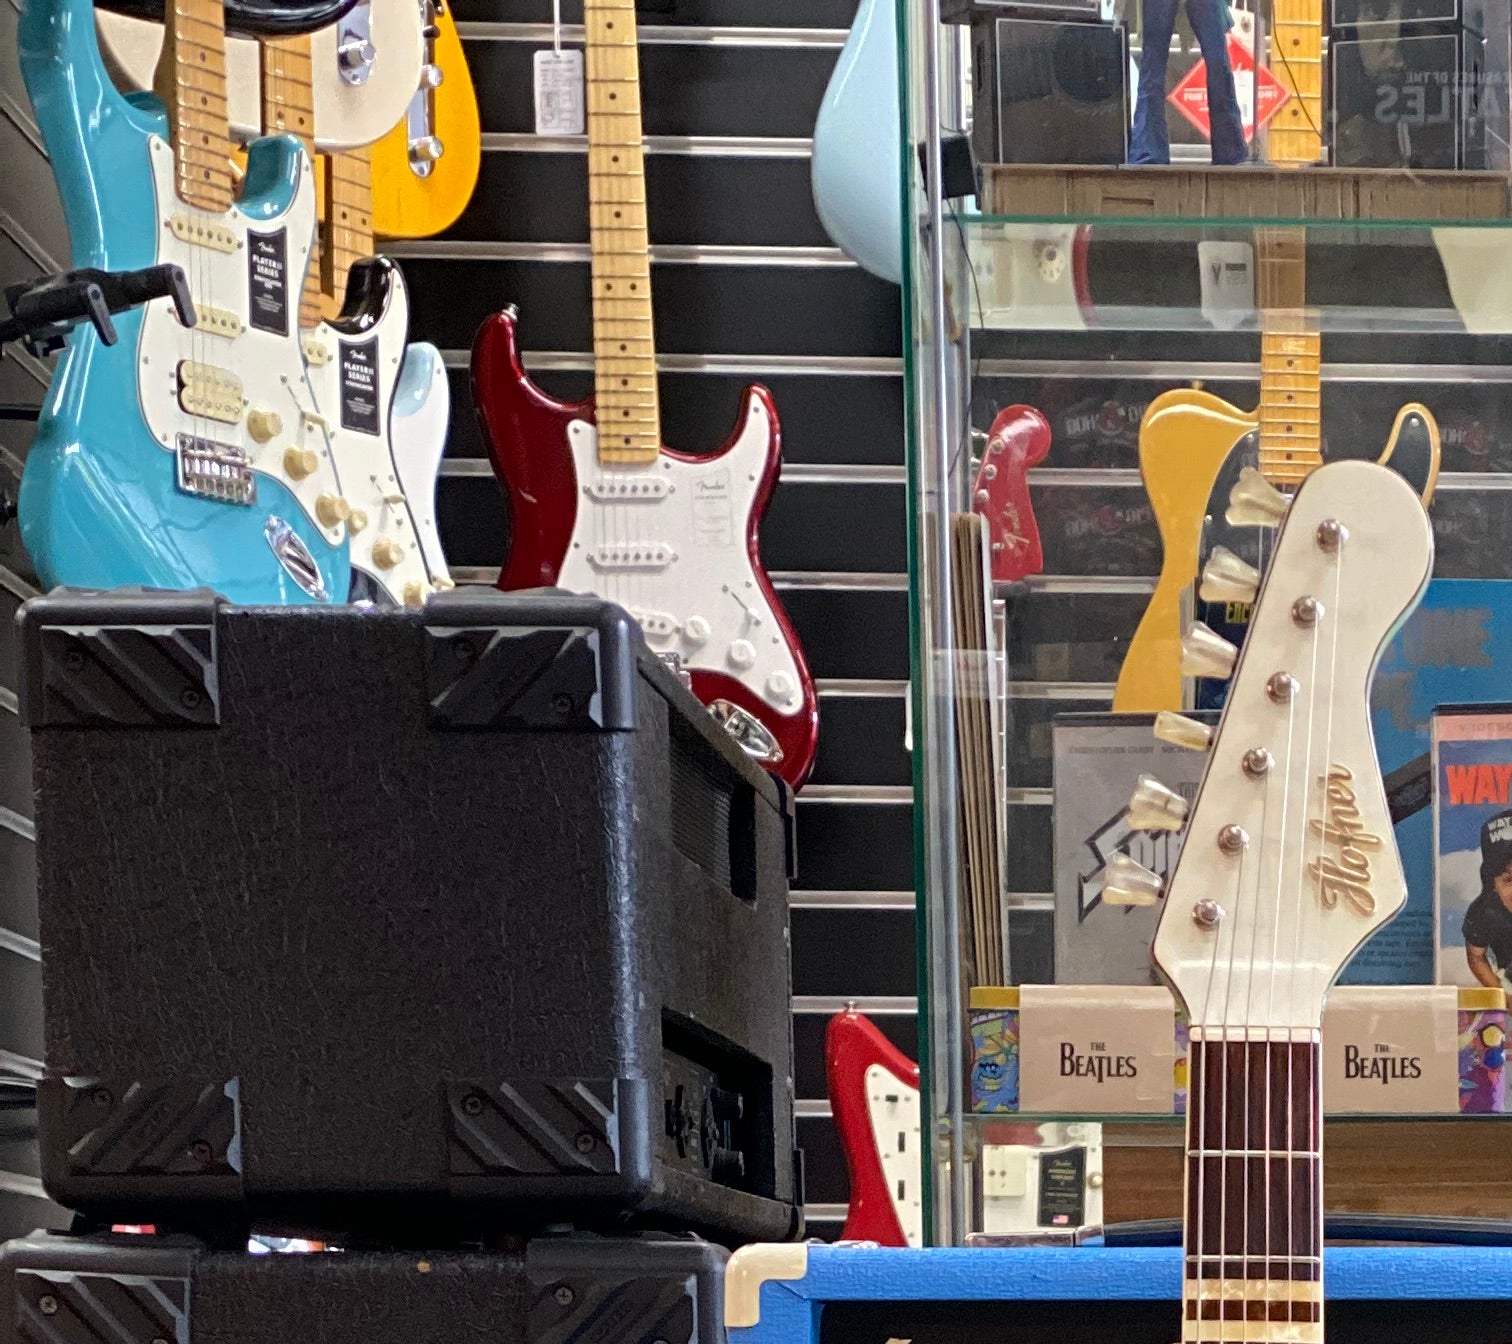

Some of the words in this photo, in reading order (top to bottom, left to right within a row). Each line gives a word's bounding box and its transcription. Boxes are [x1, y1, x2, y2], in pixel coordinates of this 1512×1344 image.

[343, 361, 369, 373] PLAYER
[1090, 1042, 1106, 1052] THE
[1060, 1042, 1137, 1083] BEATLES
[1344, 1044, 1422, 1085] BEATLES
